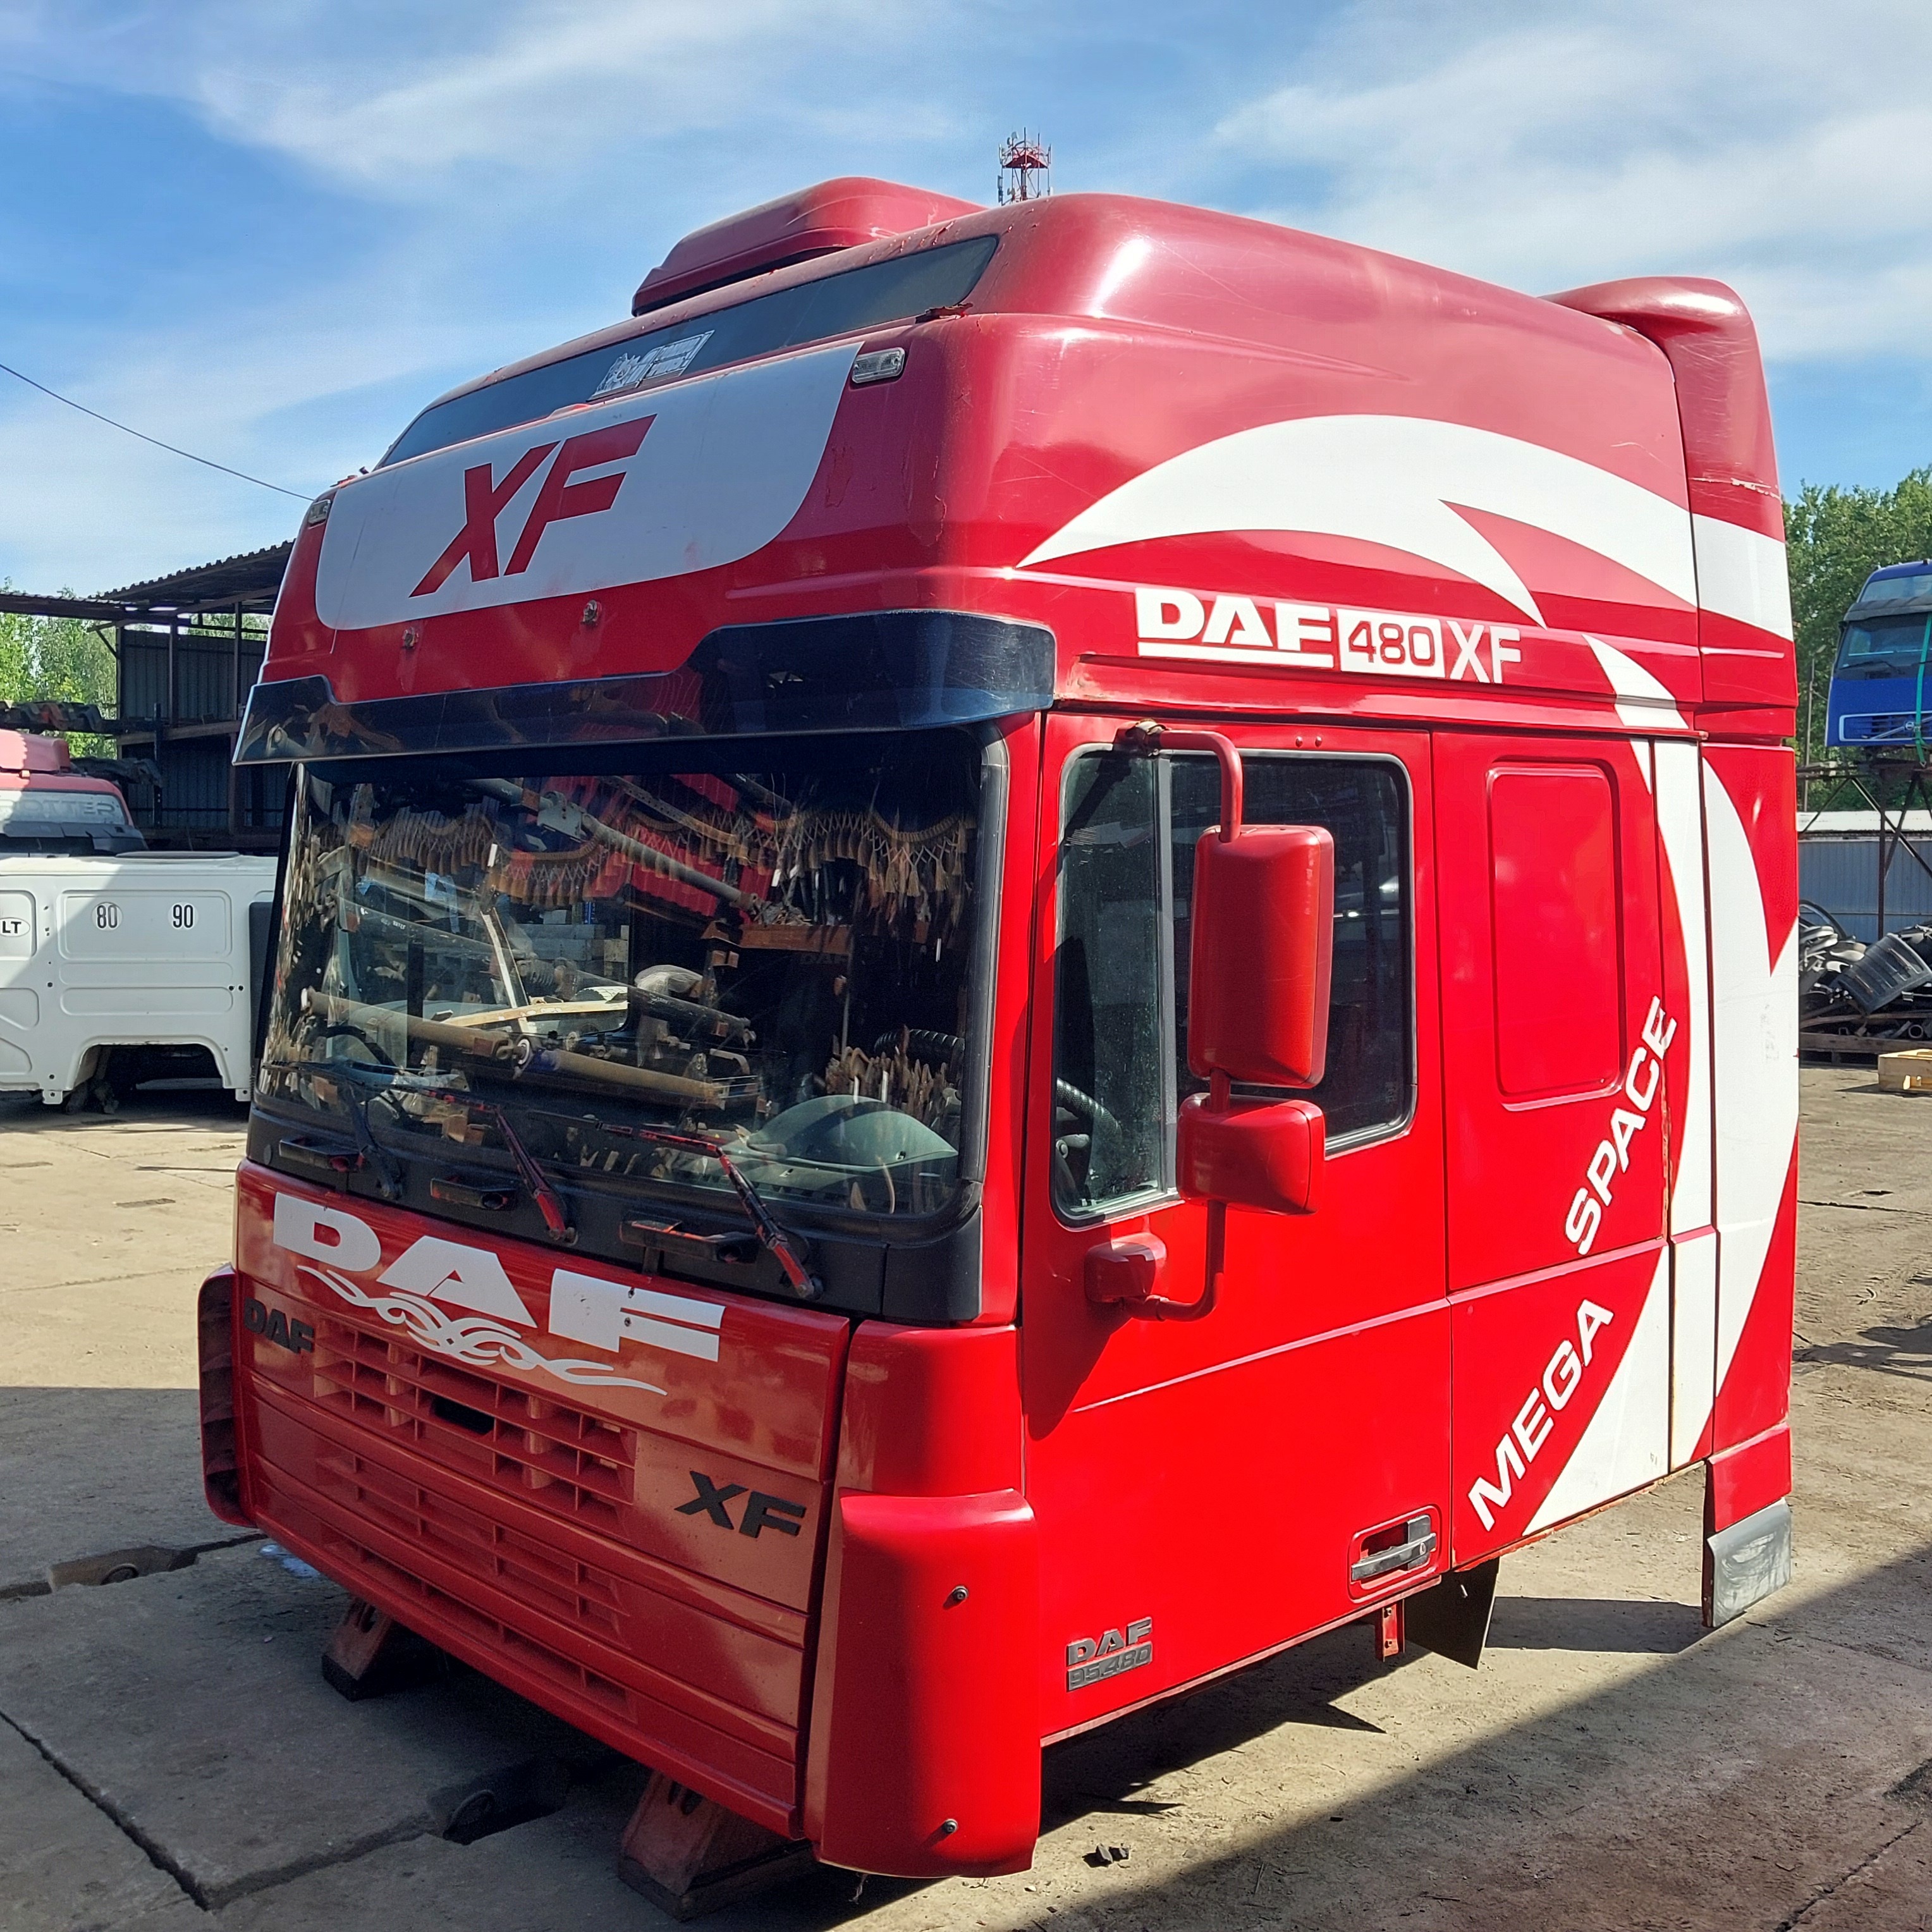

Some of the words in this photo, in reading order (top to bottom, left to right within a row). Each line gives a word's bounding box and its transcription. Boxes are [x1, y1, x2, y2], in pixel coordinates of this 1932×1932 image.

[409, 413, 657, 598] XF
[1135, 588, 1333, 652] DAF
[1348, 620, 1434, 666] 480
[1447, 620, 1521, 684] XF
[3, 920, 22, 934] LT
[97, 905, 118, 929] 80
[173, 904, 193, 929] 90
[272, 1192, 726, 1362] DAF
[1468, 1299, 1614, 1531] MEGA
[1565, 996, 1678, 1255] SPACE
[244, 1296, 314, 1354] DAF
[675, 1470, 806, 1539] XF
[1066, 1616, 1152, 1666] DAF
